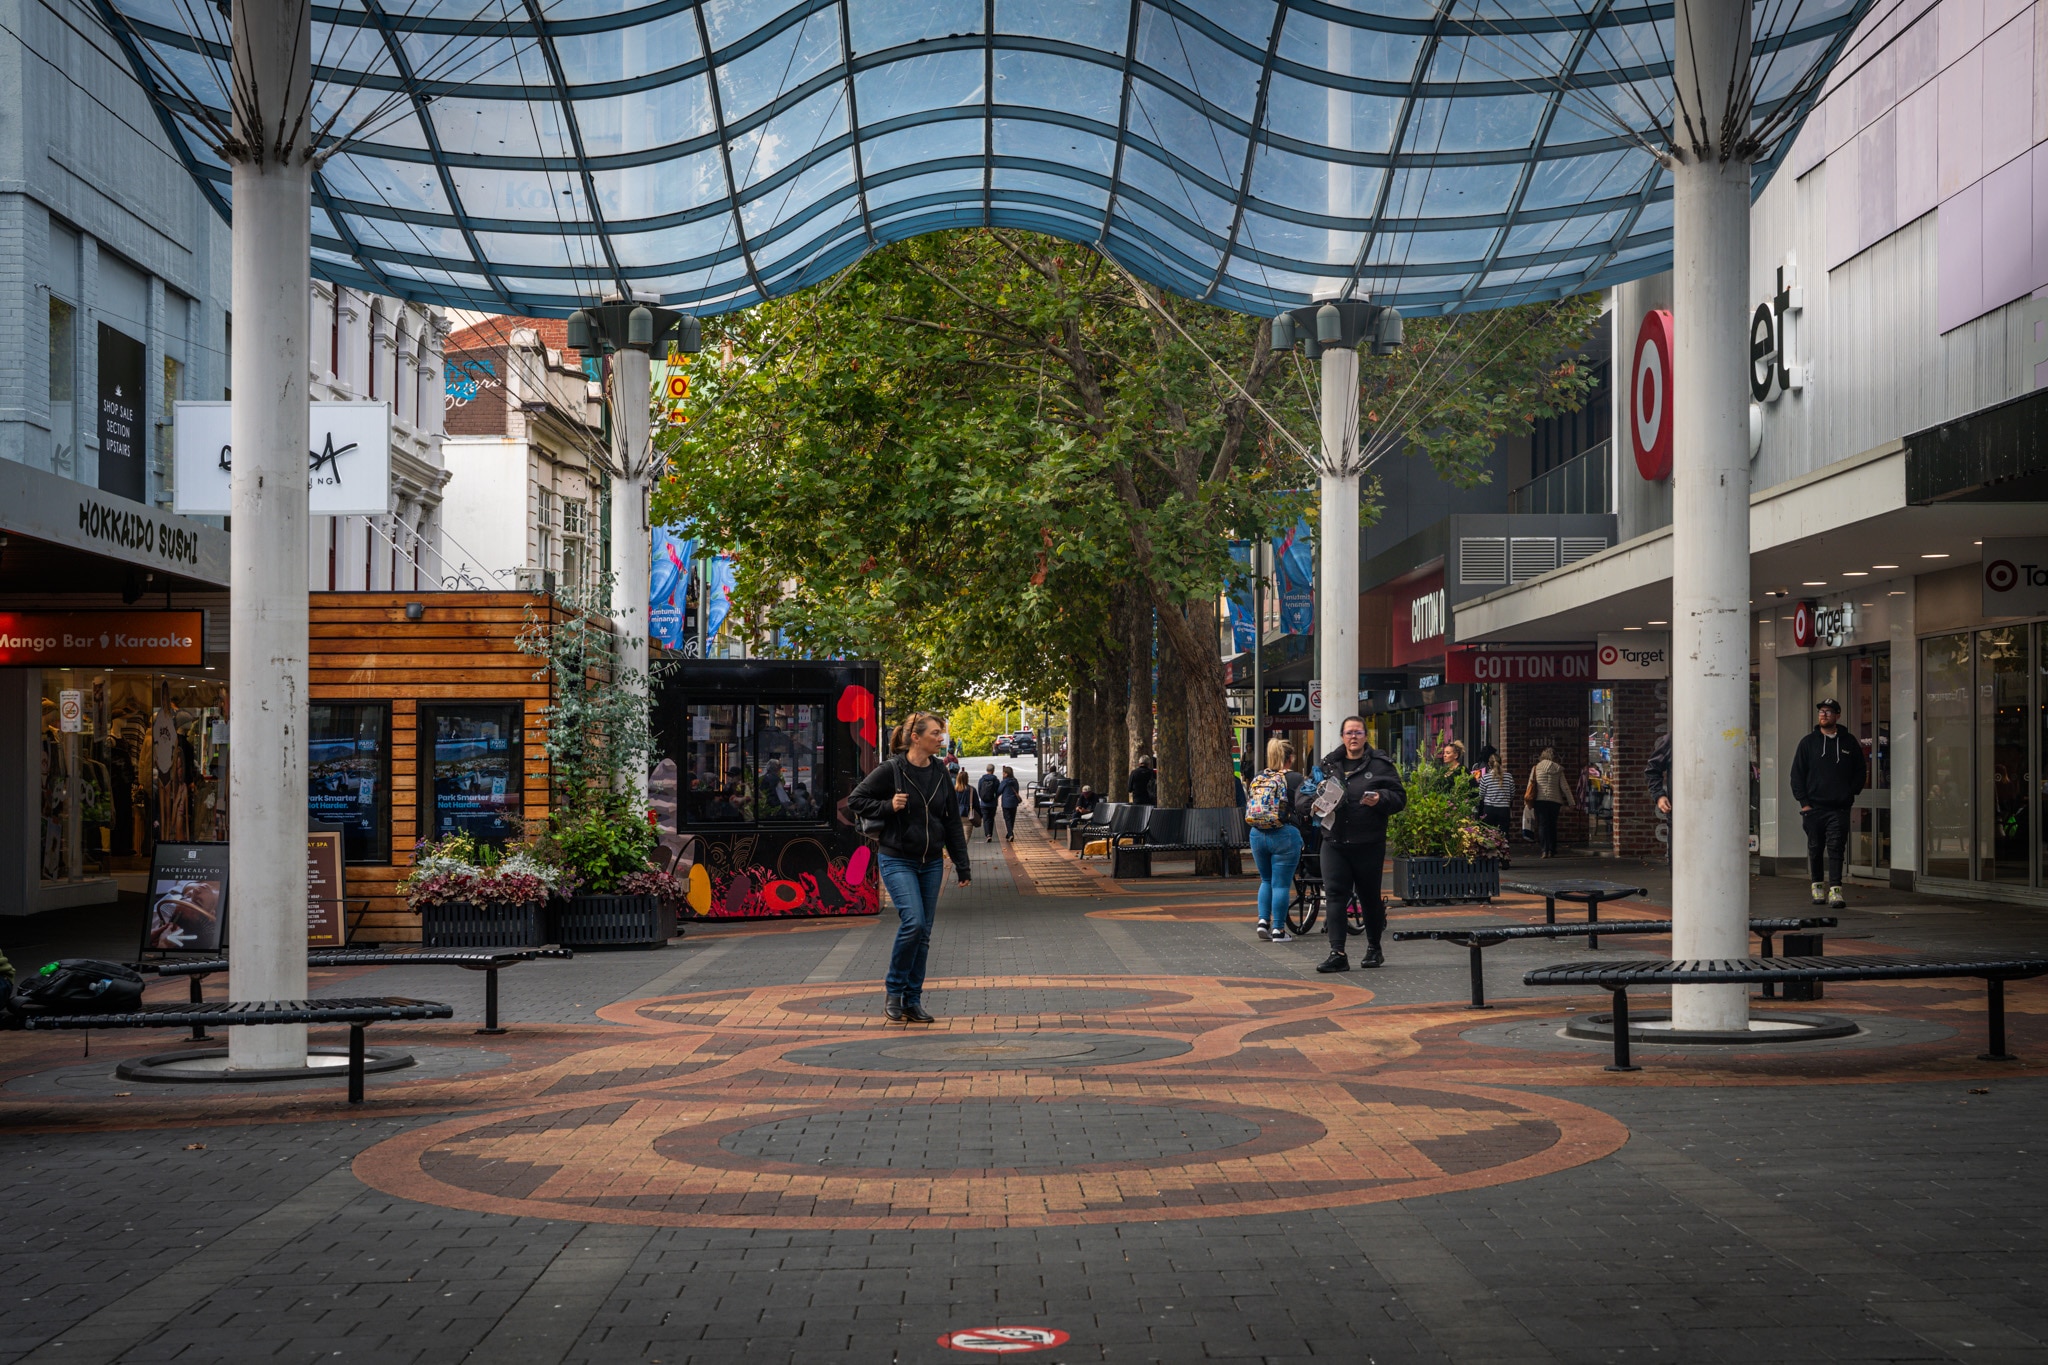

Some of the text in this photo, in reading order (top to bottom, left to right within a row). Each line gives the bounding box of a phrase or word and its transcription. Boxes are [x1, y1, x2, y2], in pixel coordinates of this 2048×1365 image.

[103, 399, 133, 421] SHOP SALE
[106, 420, 131, 438] SECTION
[106, 439, 131, 457] UPSTAIRS
[79, 499, 198, 565] HOKKAIDO SUSHI
[63, 634, 95, 647] Bar
[115, 633, 192, 647] Karaoke
[1619, 649, 1664, 667] Target
[1279, 693, 1307, 713] JD
[438, 801, 481, 809] Not Harder.
